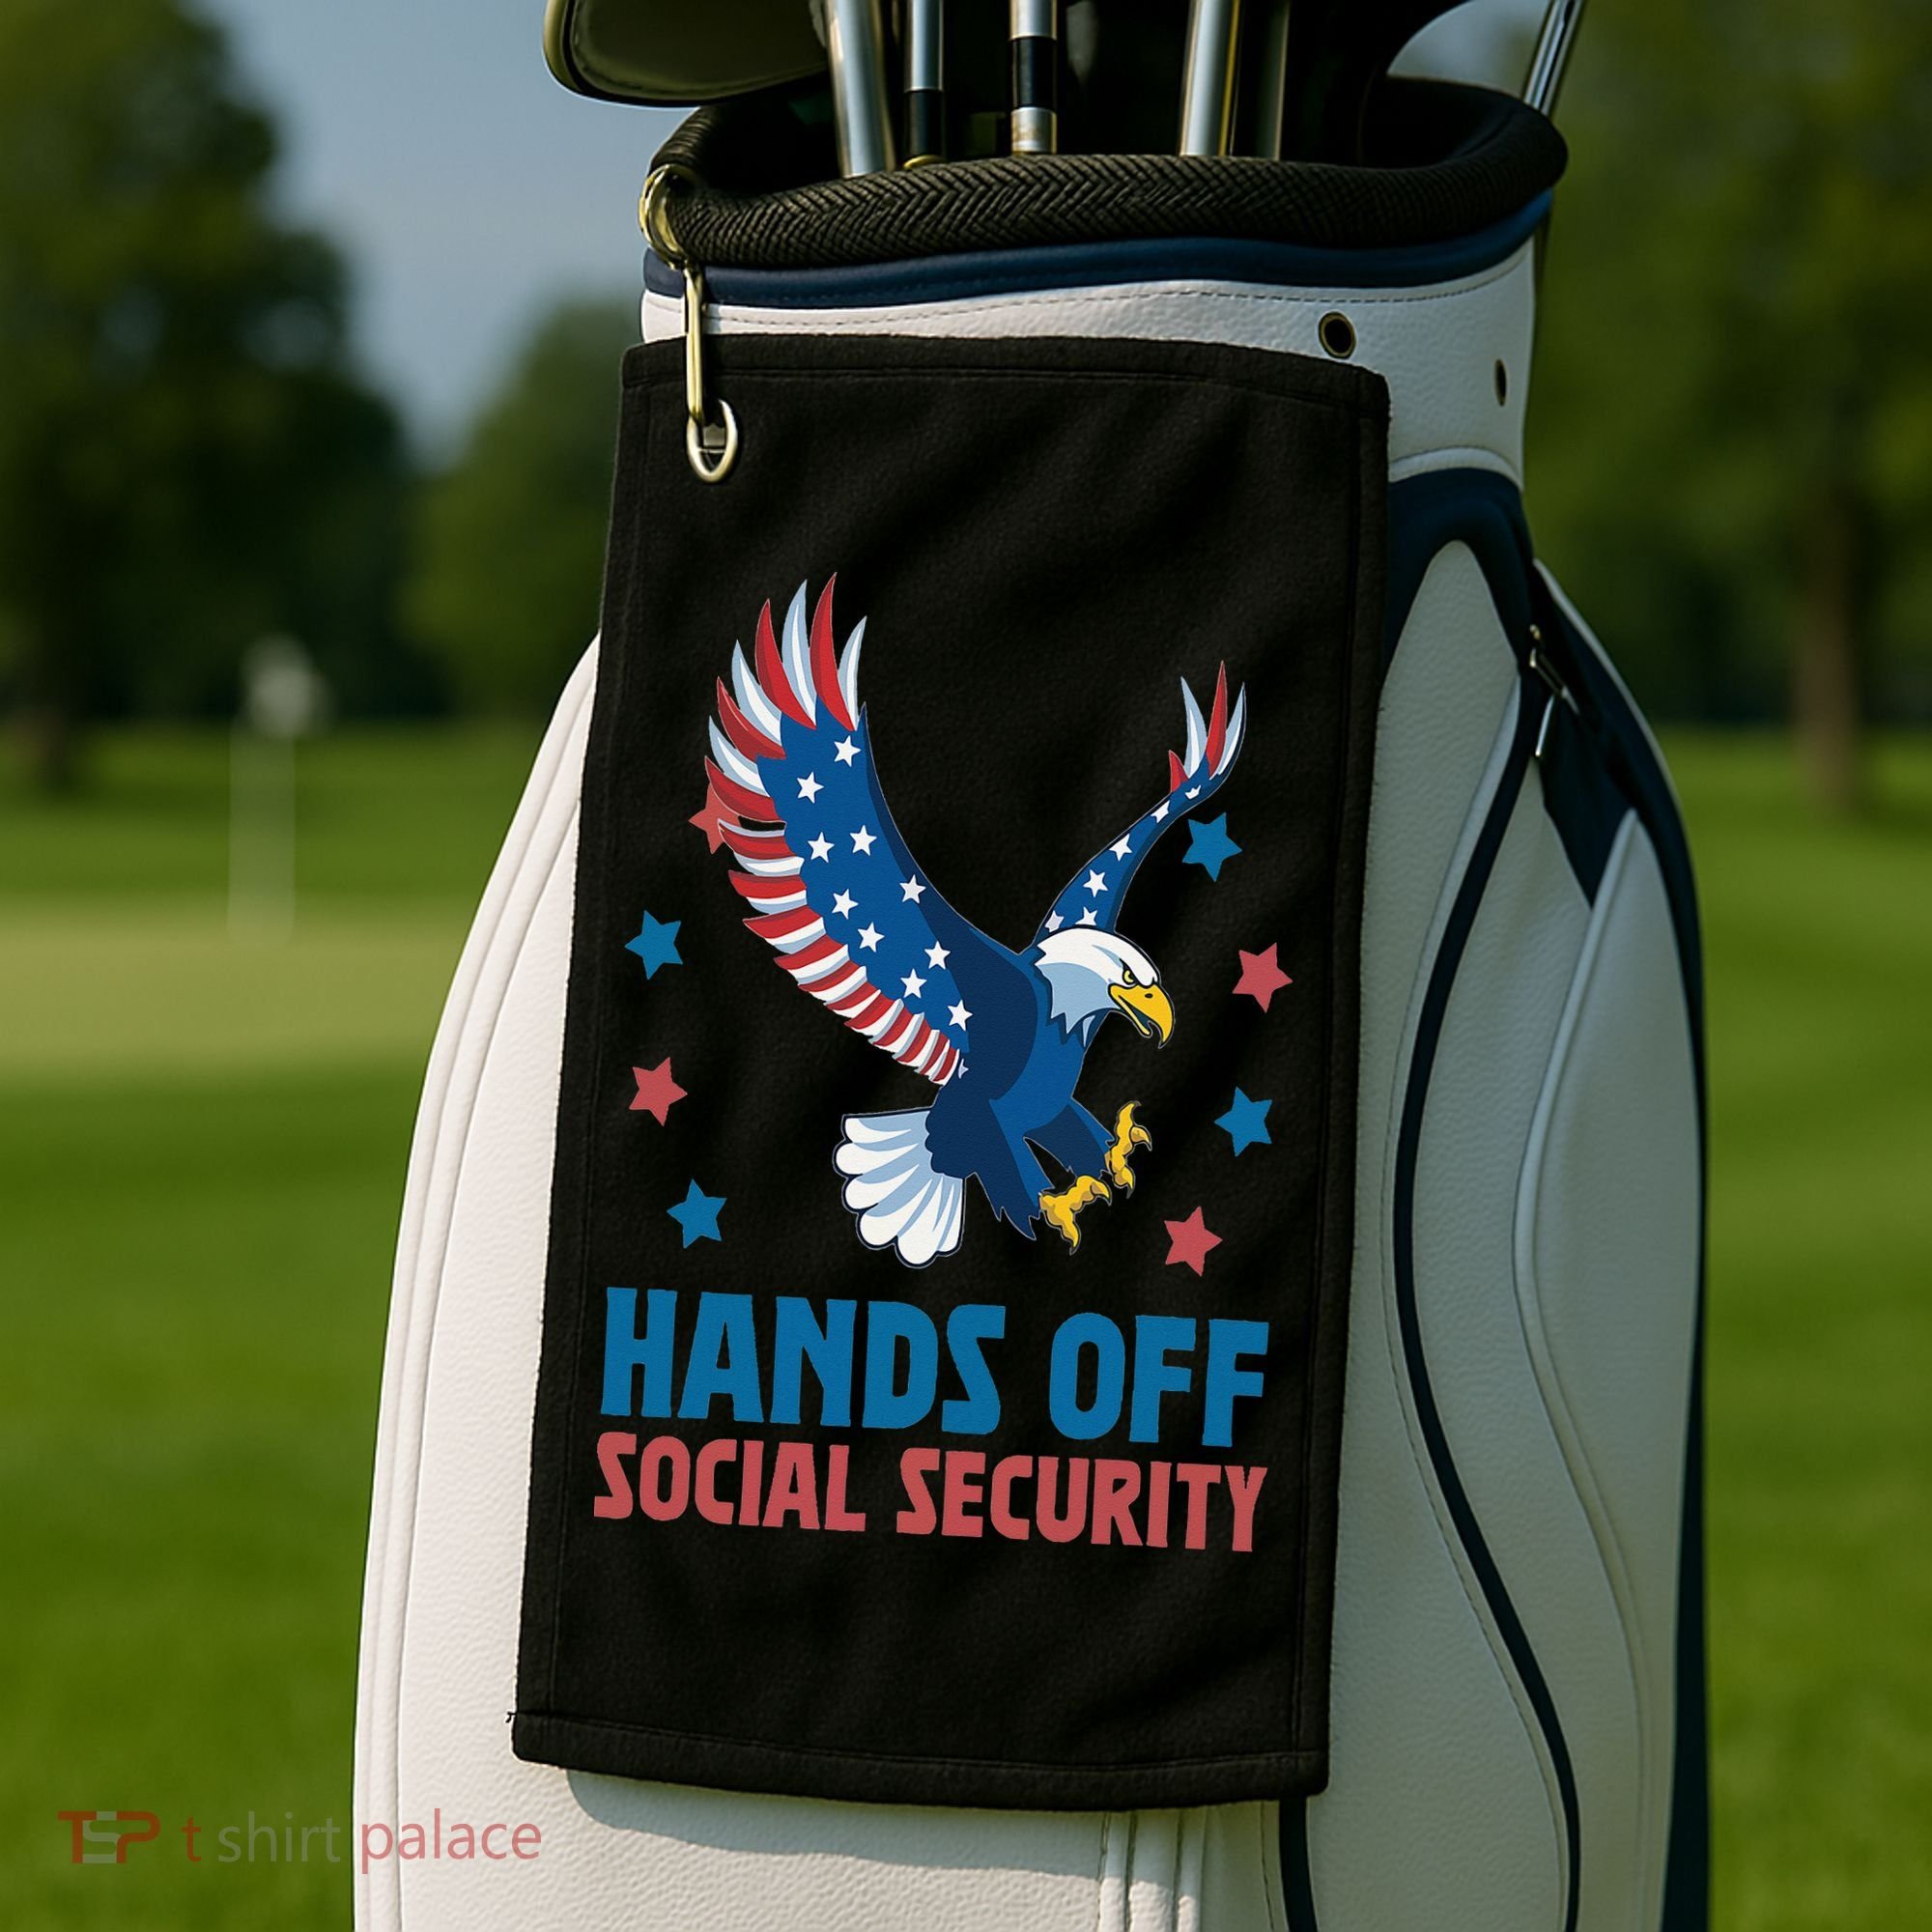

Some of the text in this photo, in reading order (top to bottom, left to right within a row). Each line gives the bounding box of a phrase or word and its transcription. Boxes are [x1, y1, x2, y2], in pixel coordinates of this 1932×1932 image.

[601, 1287, 1269, 1447] HANDS OFF
[593, 1432, 1268, 1552] SOCIAL SECURITY
